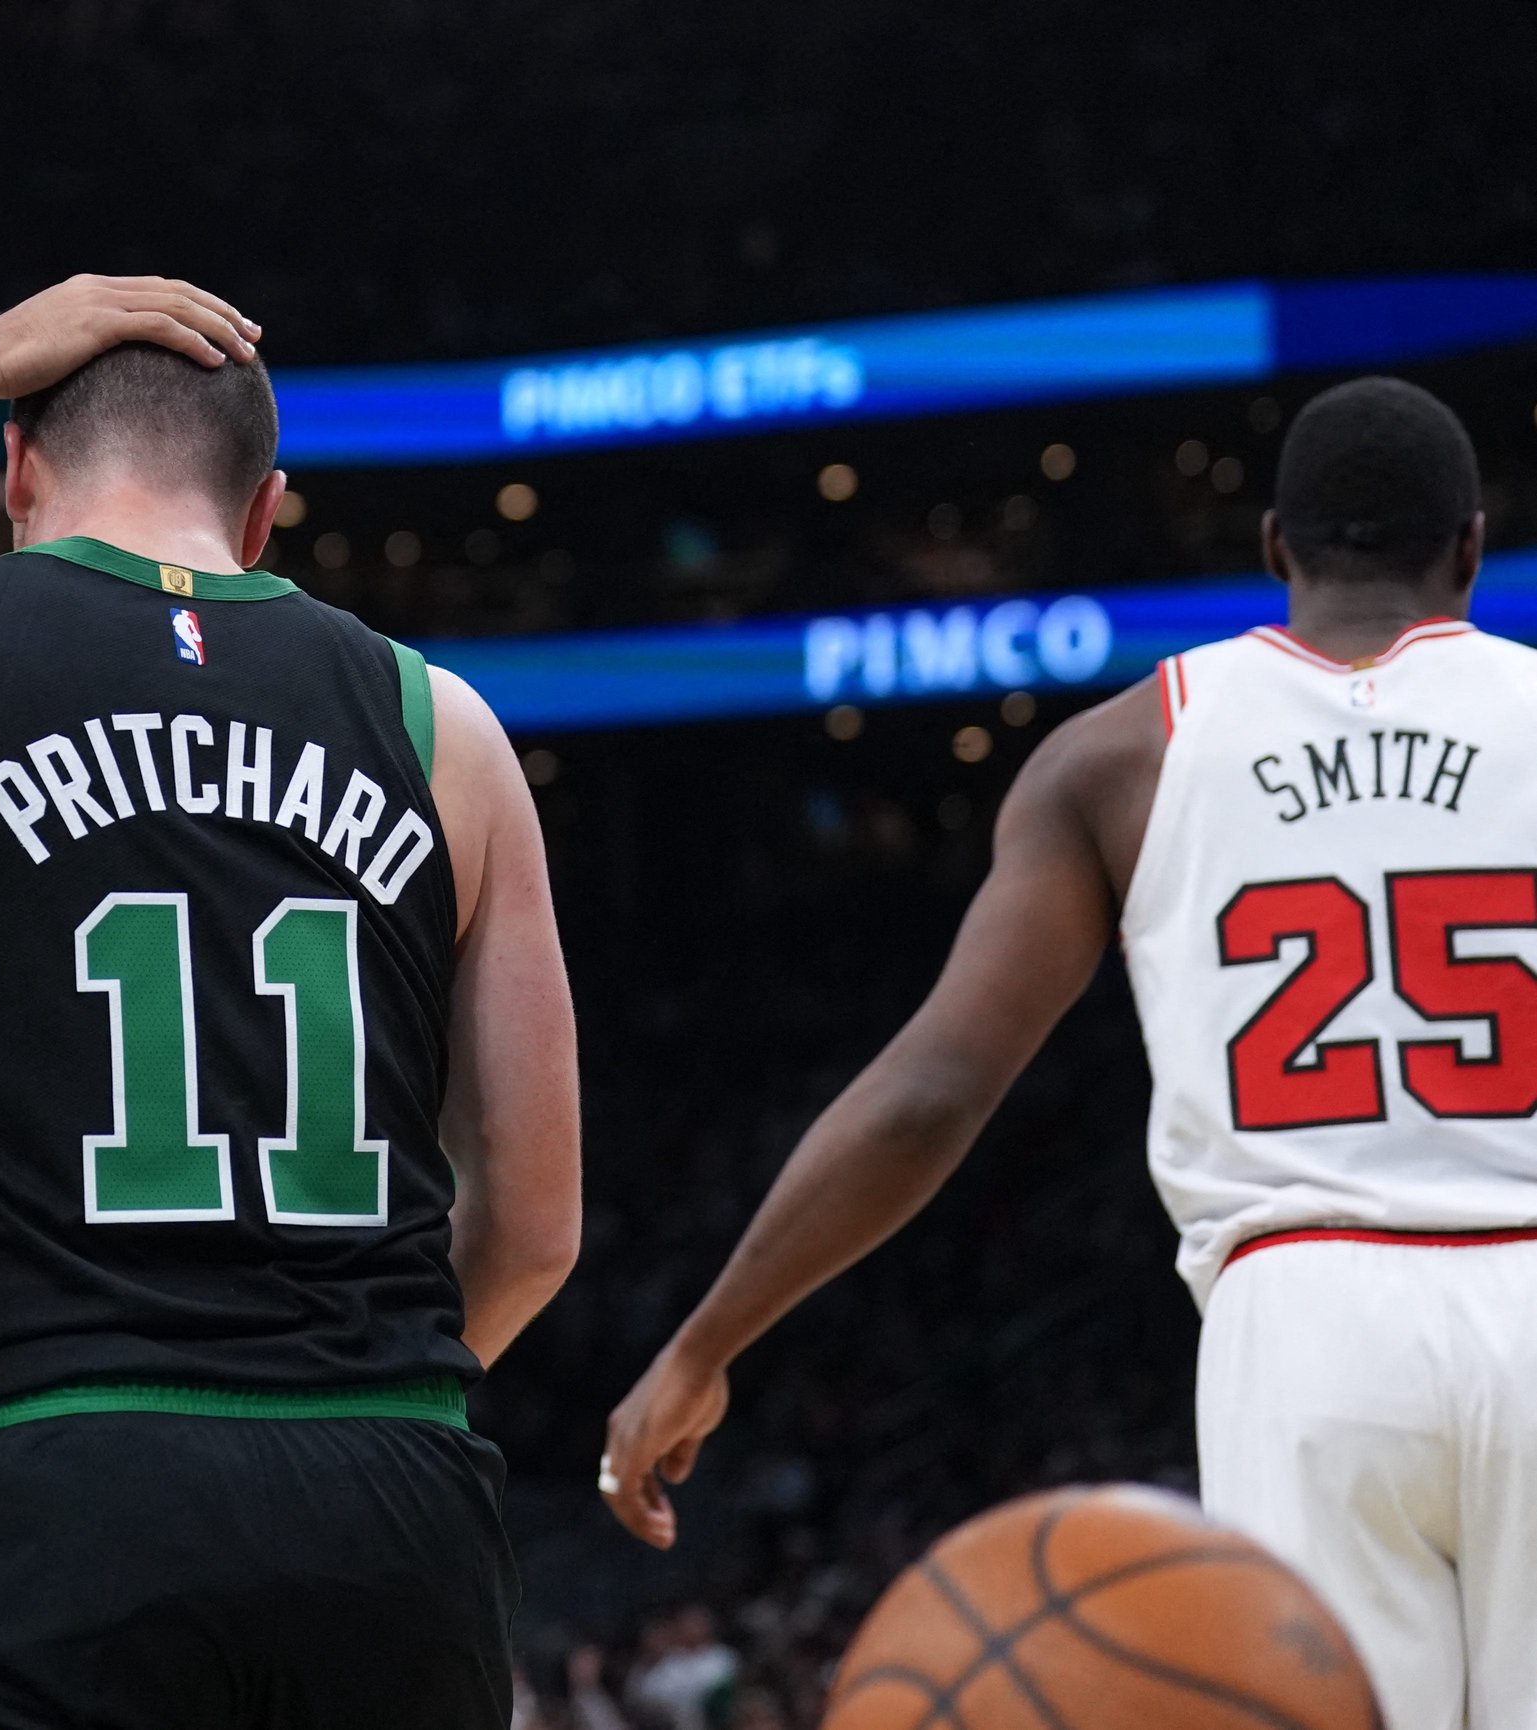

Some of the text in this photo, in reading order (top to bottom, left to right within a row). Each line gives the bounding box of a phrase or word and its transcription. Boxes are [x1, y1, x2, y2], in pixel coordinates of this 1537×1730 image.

[180, 648, 195, 660] NBA
[805, 595, 1112, 702] PIMCO
[1252, 728, 1480, 823] SMITH
[1216, 867, 1537, 1133] 25
[74, 892, 390, 1227] 11
